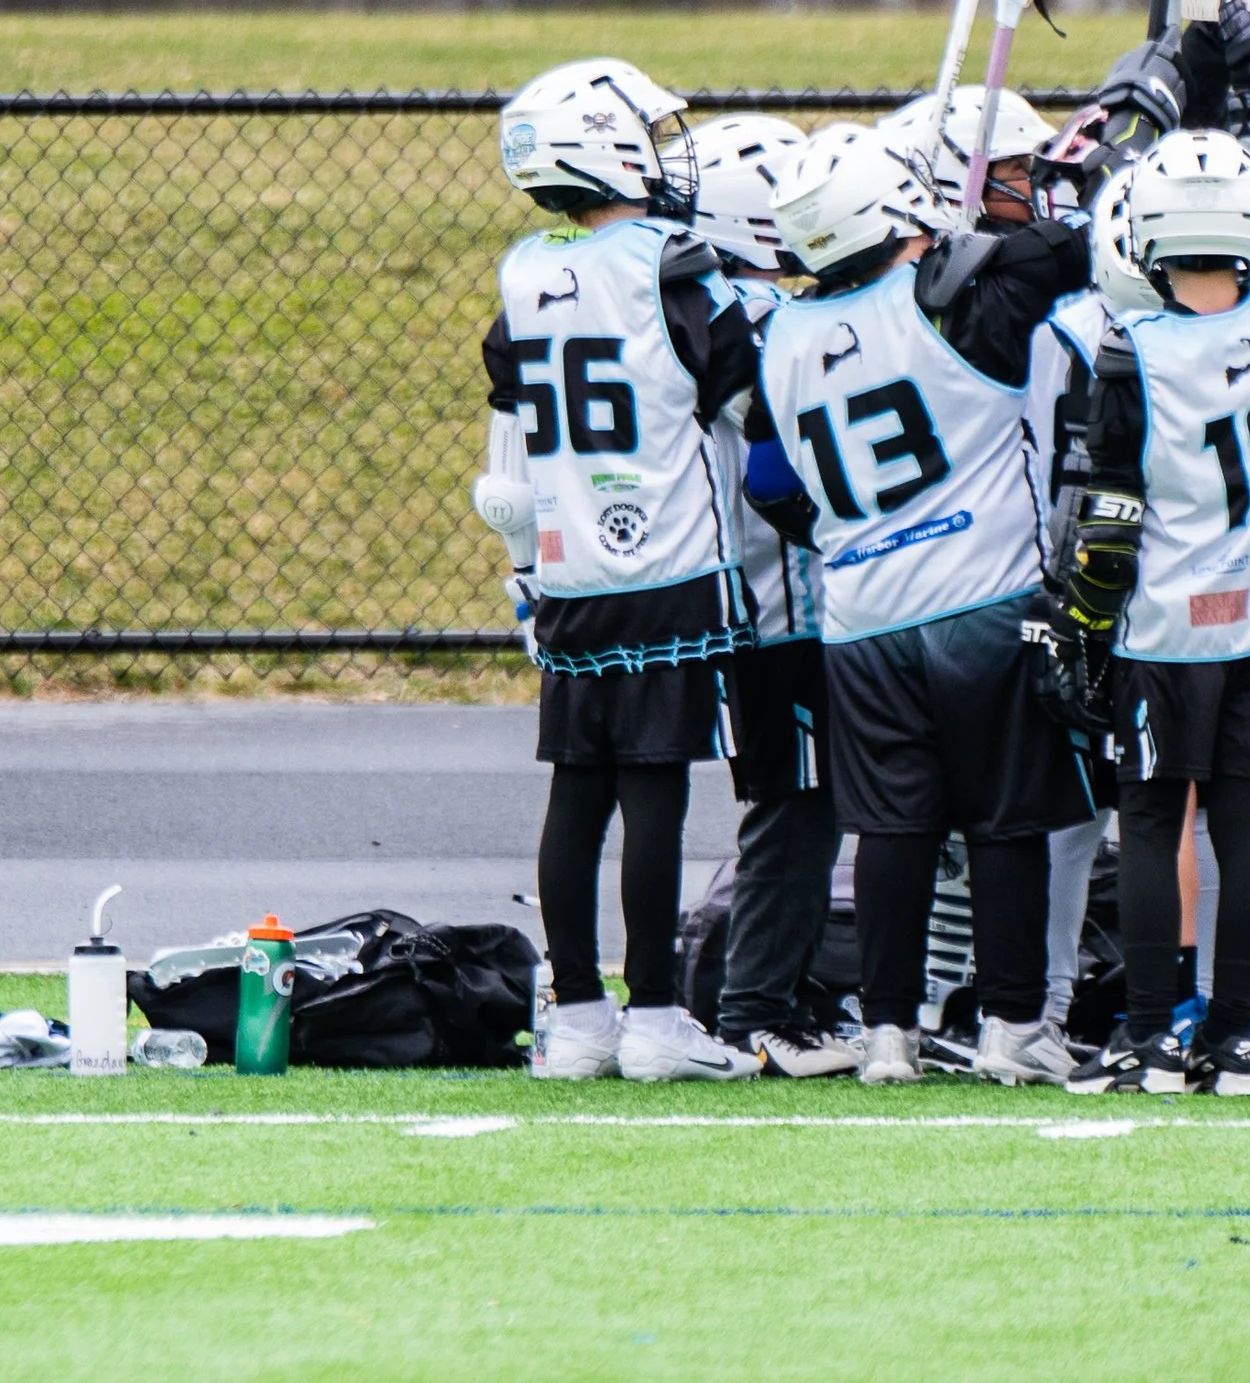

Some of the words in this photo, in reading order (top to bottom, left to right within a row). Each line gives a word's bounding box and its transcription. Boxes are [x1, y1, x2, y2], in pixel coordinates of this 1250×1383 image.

[511, 336, 639, 456] 56
[796, 378, 952, 520] 13
[613, 503, 634, 511] DOG
[1020, 619, 1060, 658] STX
